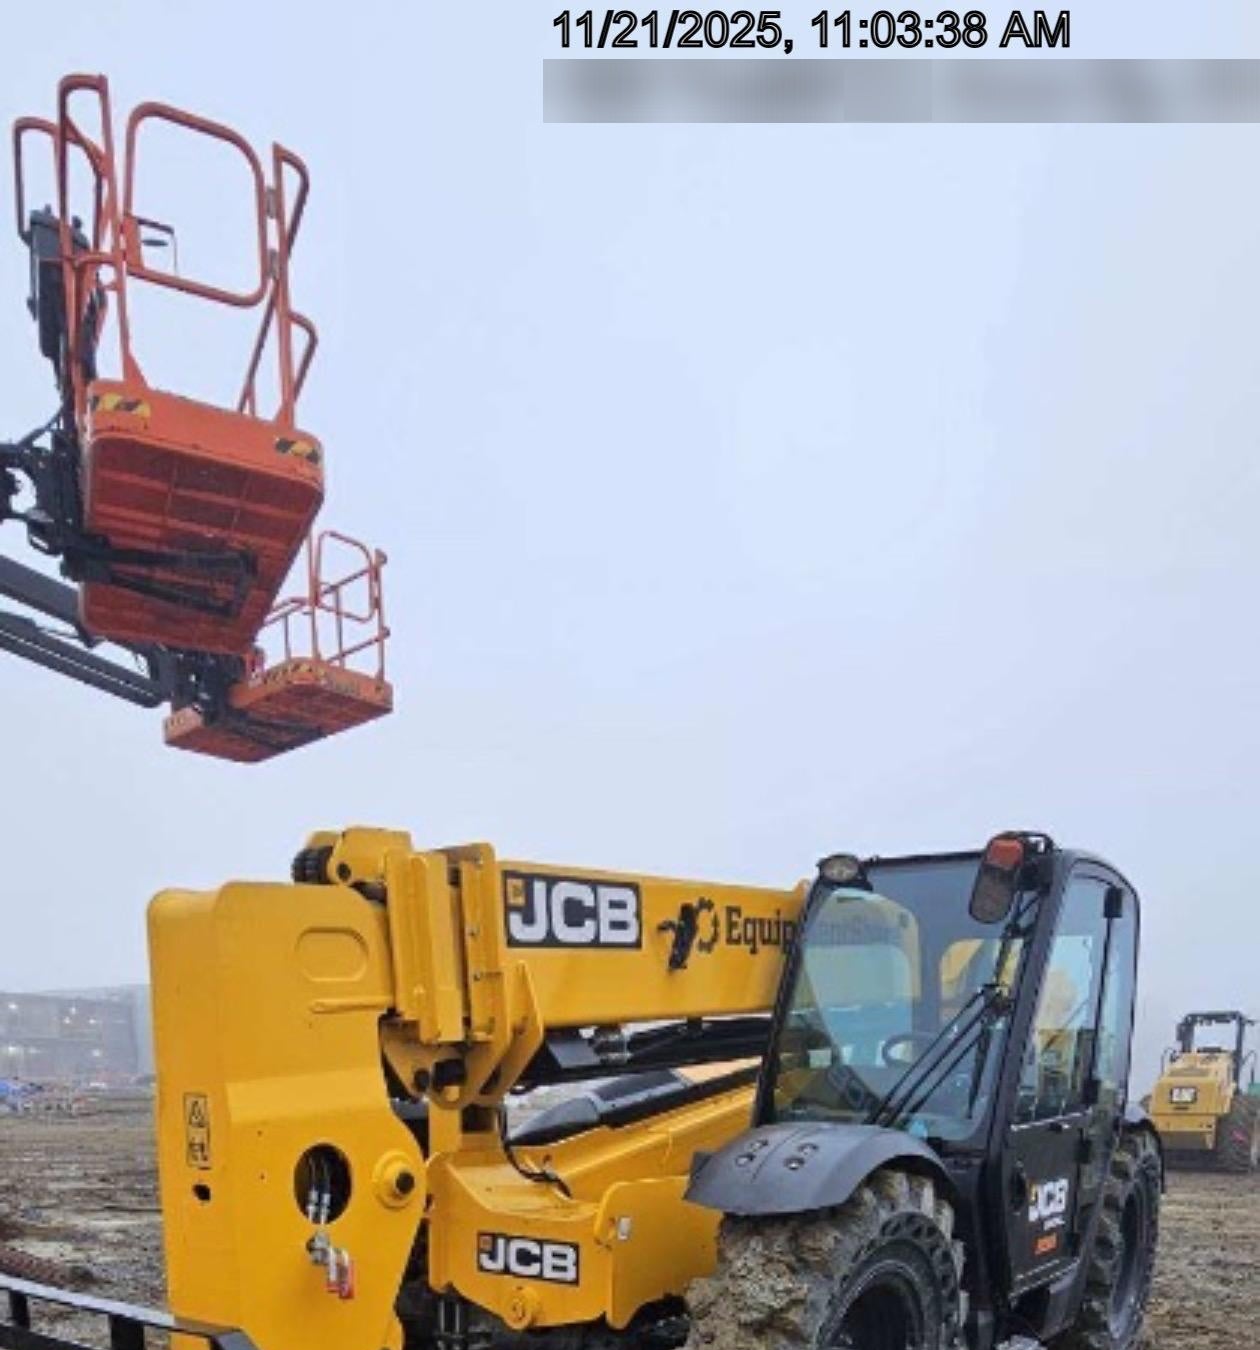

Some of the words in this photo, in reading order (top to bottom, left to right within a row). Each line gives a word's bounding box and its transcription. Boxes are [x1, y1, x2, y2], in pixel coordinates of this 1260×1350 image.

[508, 879, 640, 943] JCB
[1028, 1178, 1068, 1222] JCB
[480, 1237, 577, 1282] JCB
